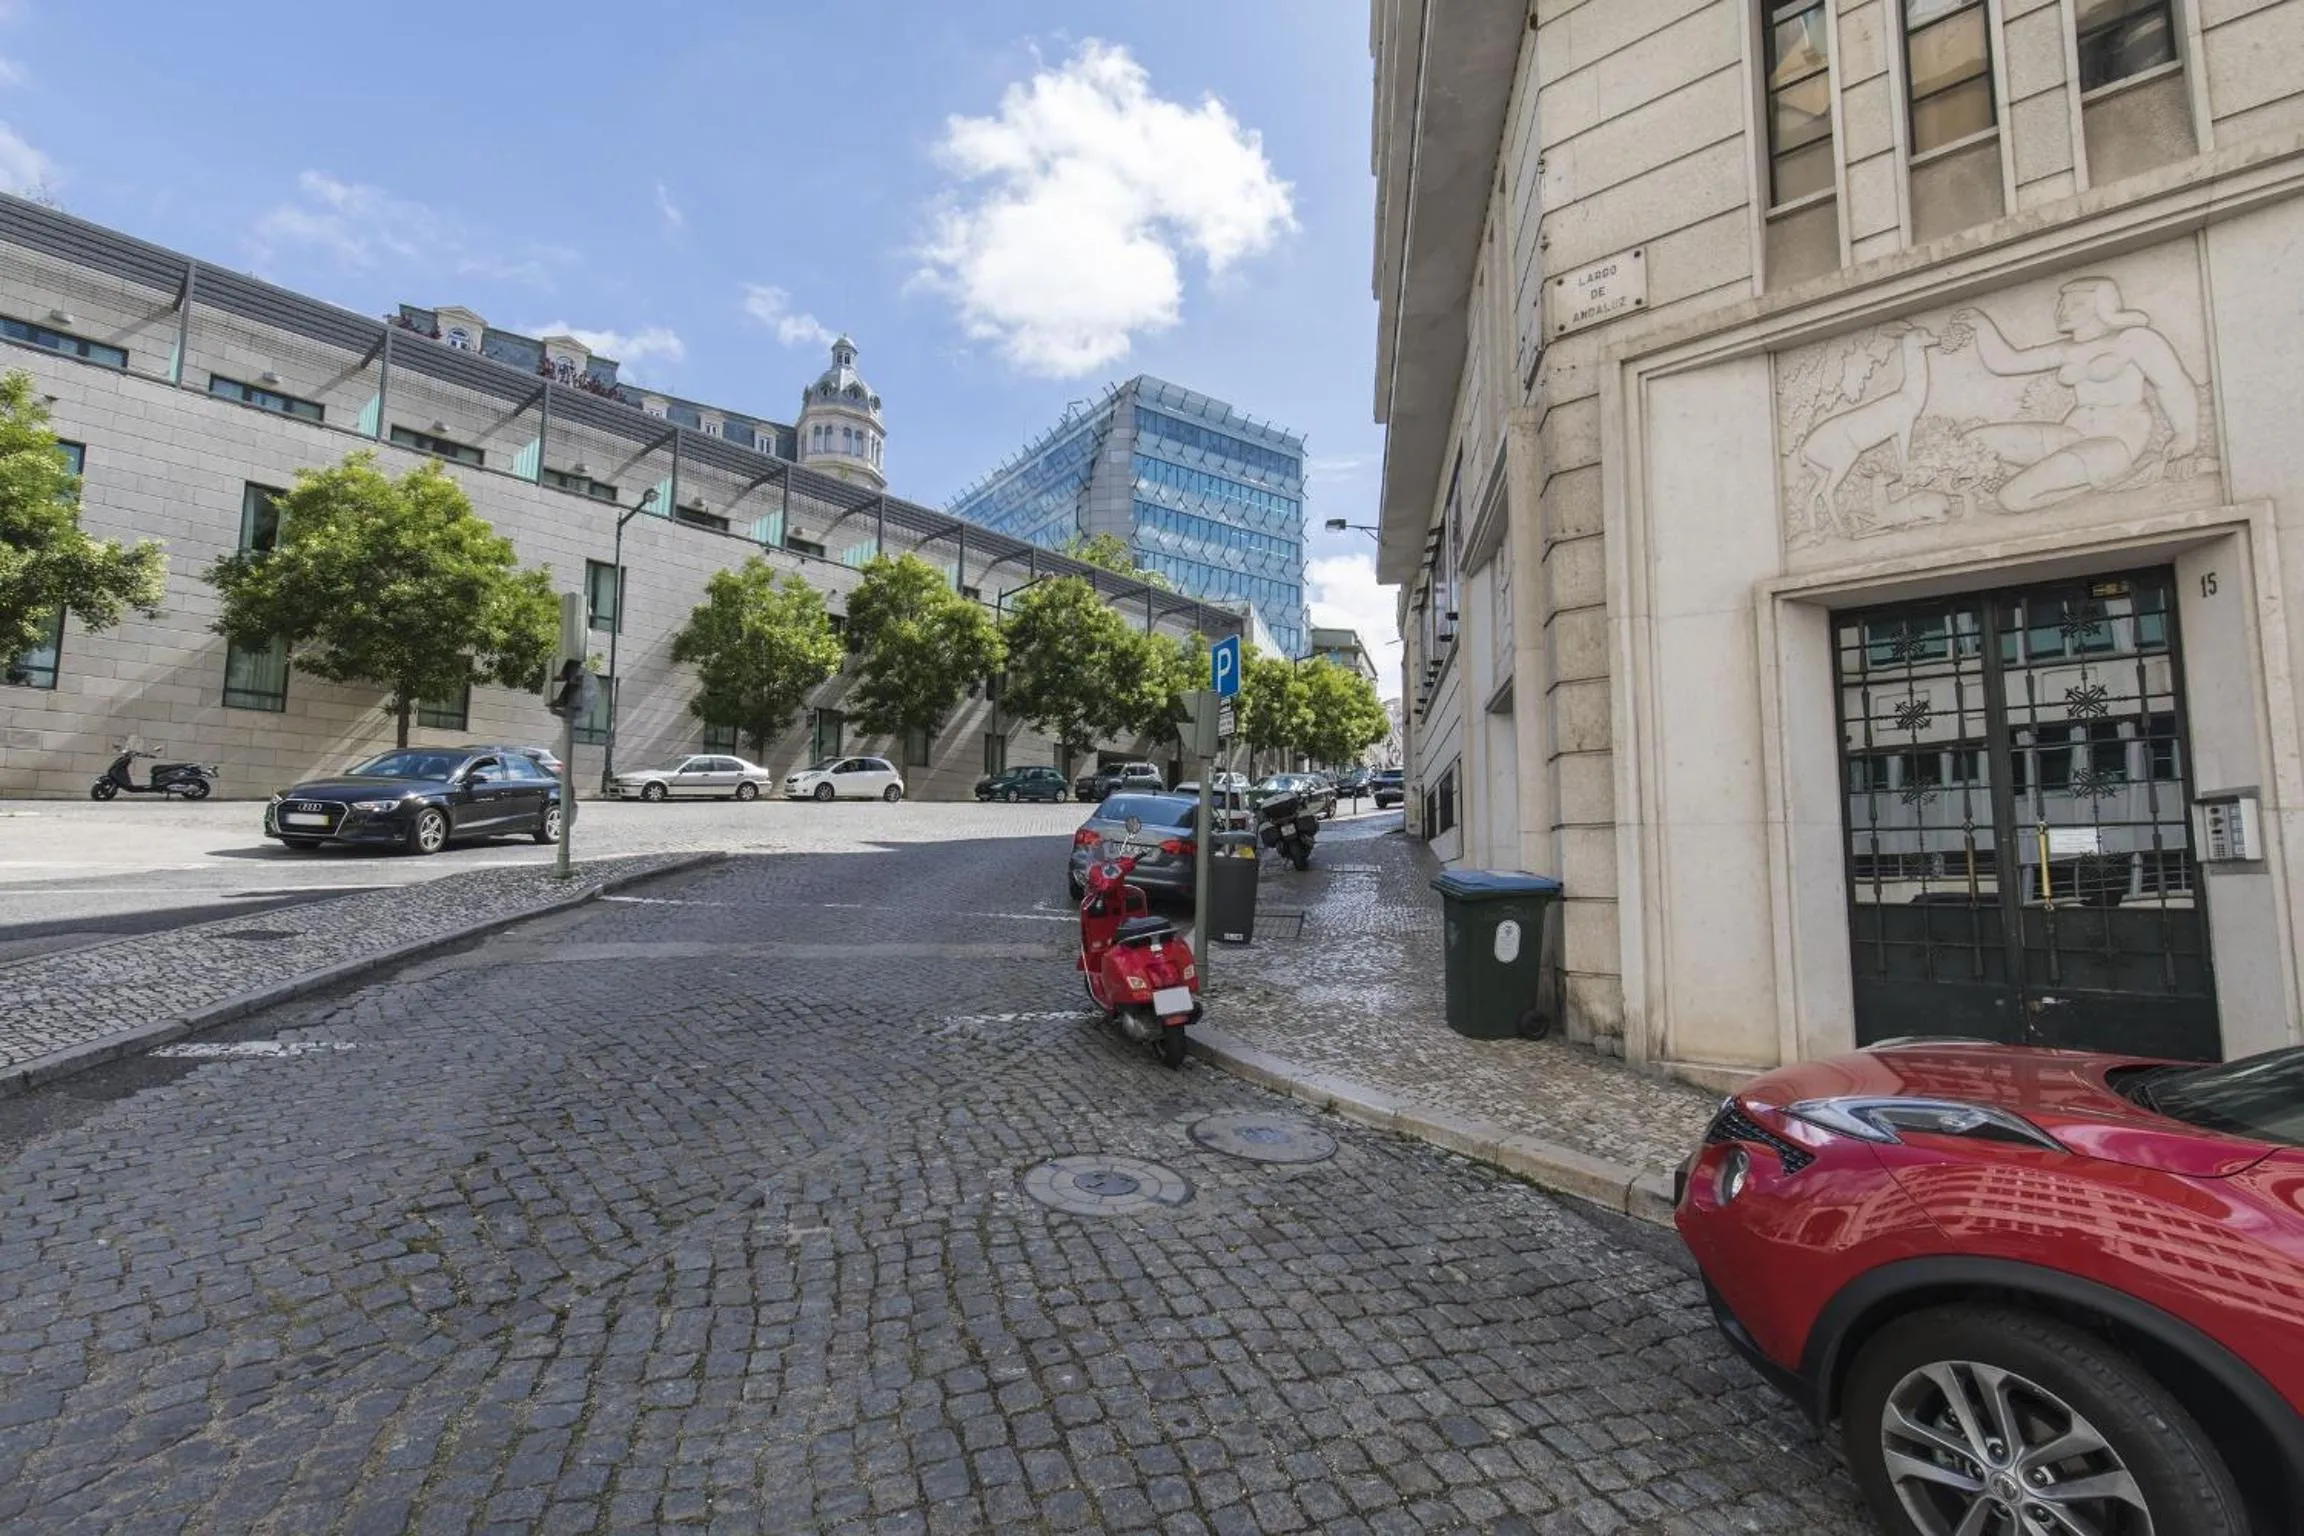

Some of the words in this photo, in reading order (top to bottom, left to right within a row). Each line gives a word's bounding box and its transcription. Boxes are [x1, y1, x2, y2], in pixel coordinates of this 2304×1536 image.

[1578, 264, 1617, 286] LARGO
[1591, 286, 1606, 300] DE
[1573, 296, 1627, 322] ANDALUZ
[2200, 571, 2218, 599] 15
[1217, 647, 1232, 693] P
